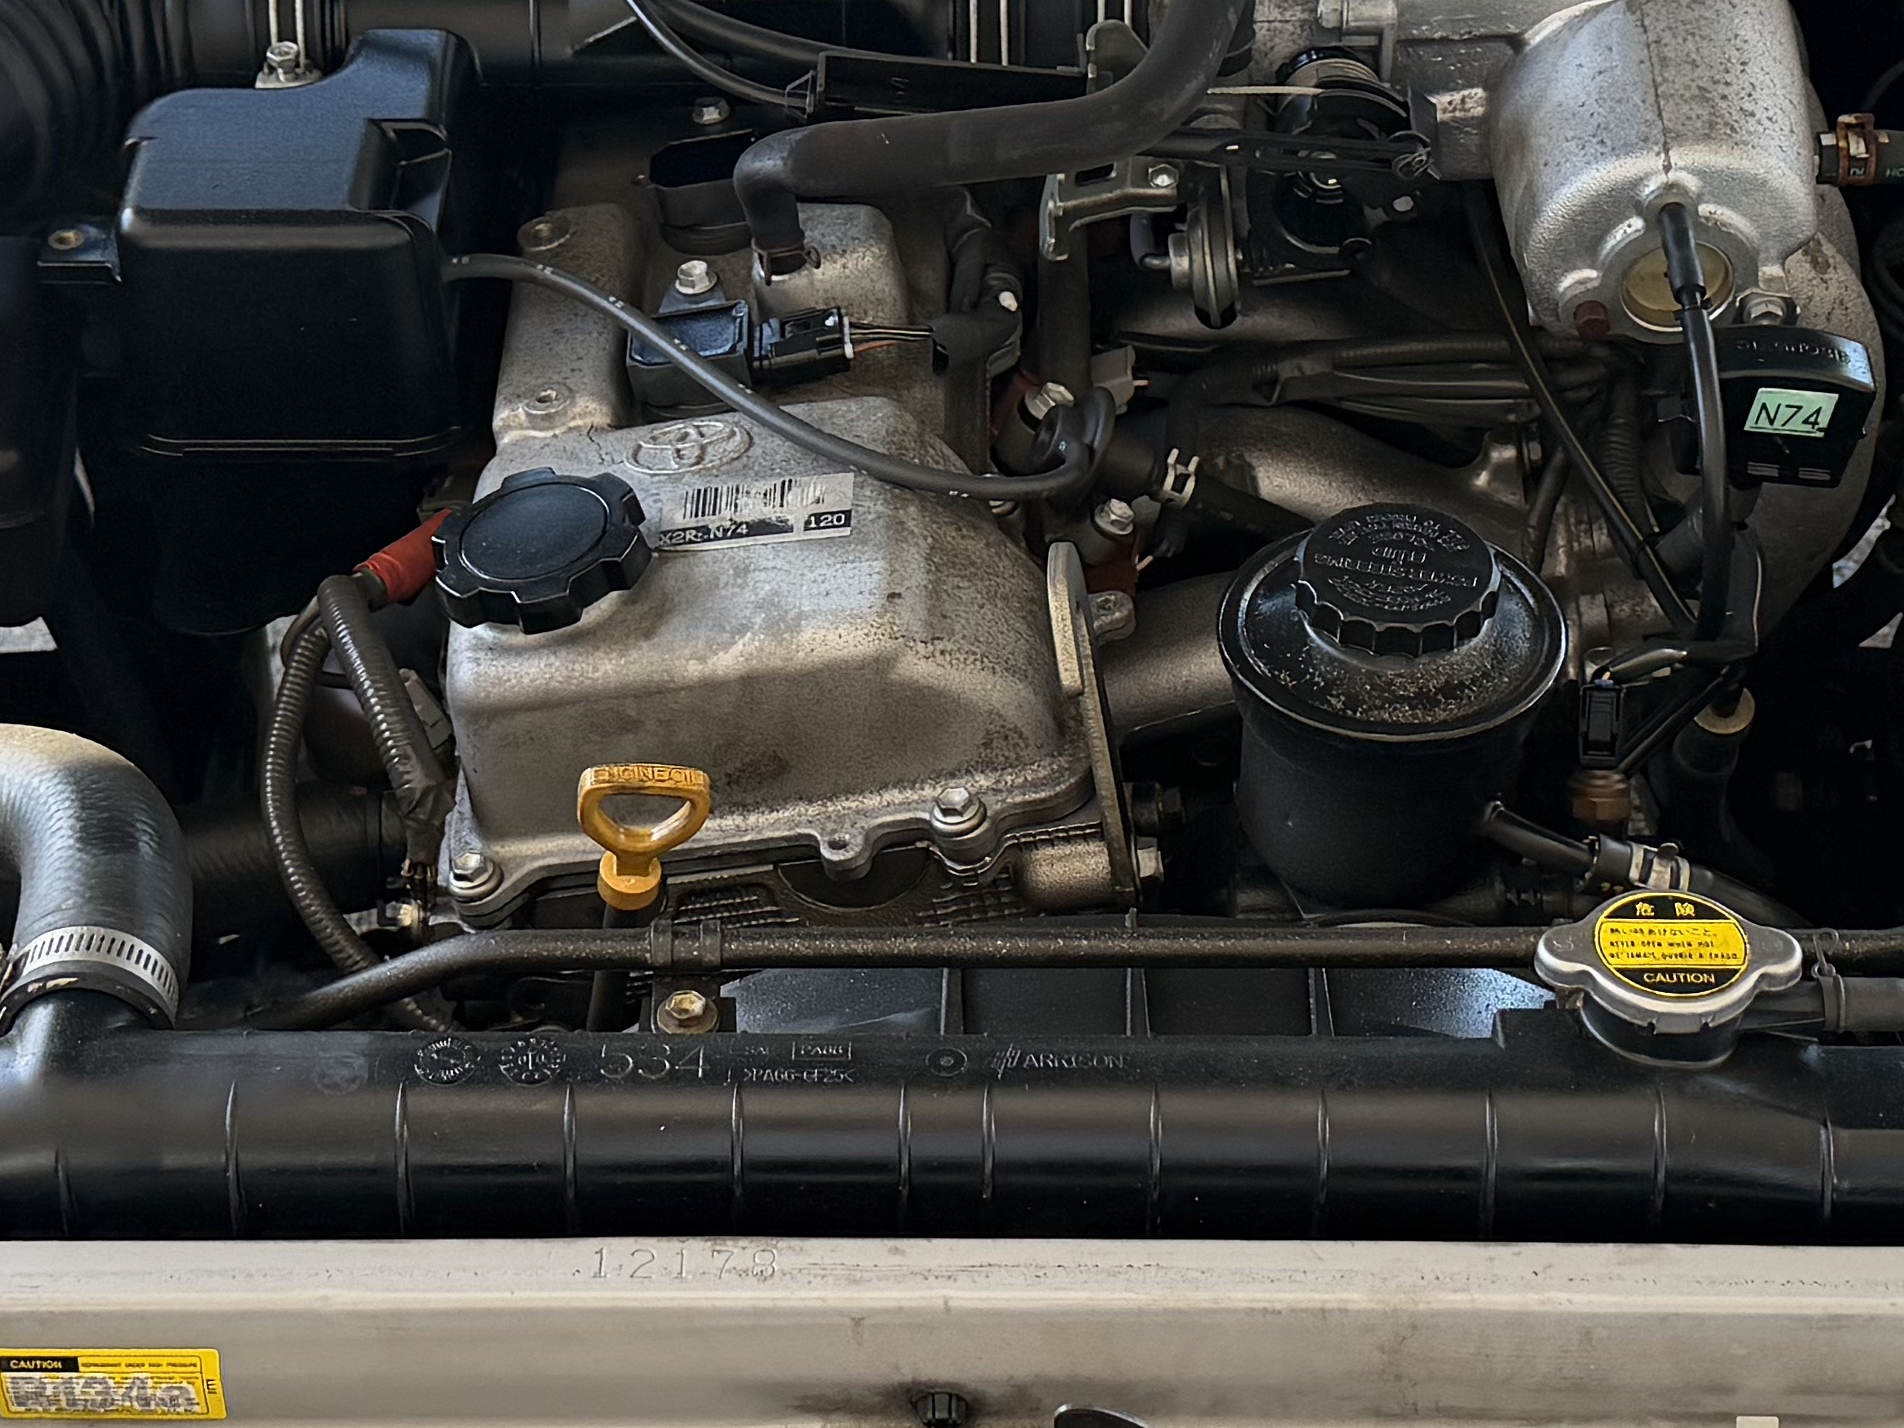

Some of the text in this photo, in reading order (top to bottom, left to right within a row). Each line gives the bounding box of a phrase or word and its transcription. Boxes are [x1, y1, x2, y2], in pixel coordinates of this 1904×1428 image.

[1755, 402, 1822, 429] N74
[807, 513, 845, 528] 120
[1644, 973, 1715, 983] CAUTION
[600, 1044, 709, 1079] 534
[594, 1247, 780, 1280] 12178
[10, 1360, 62, 1369] CAUTION
